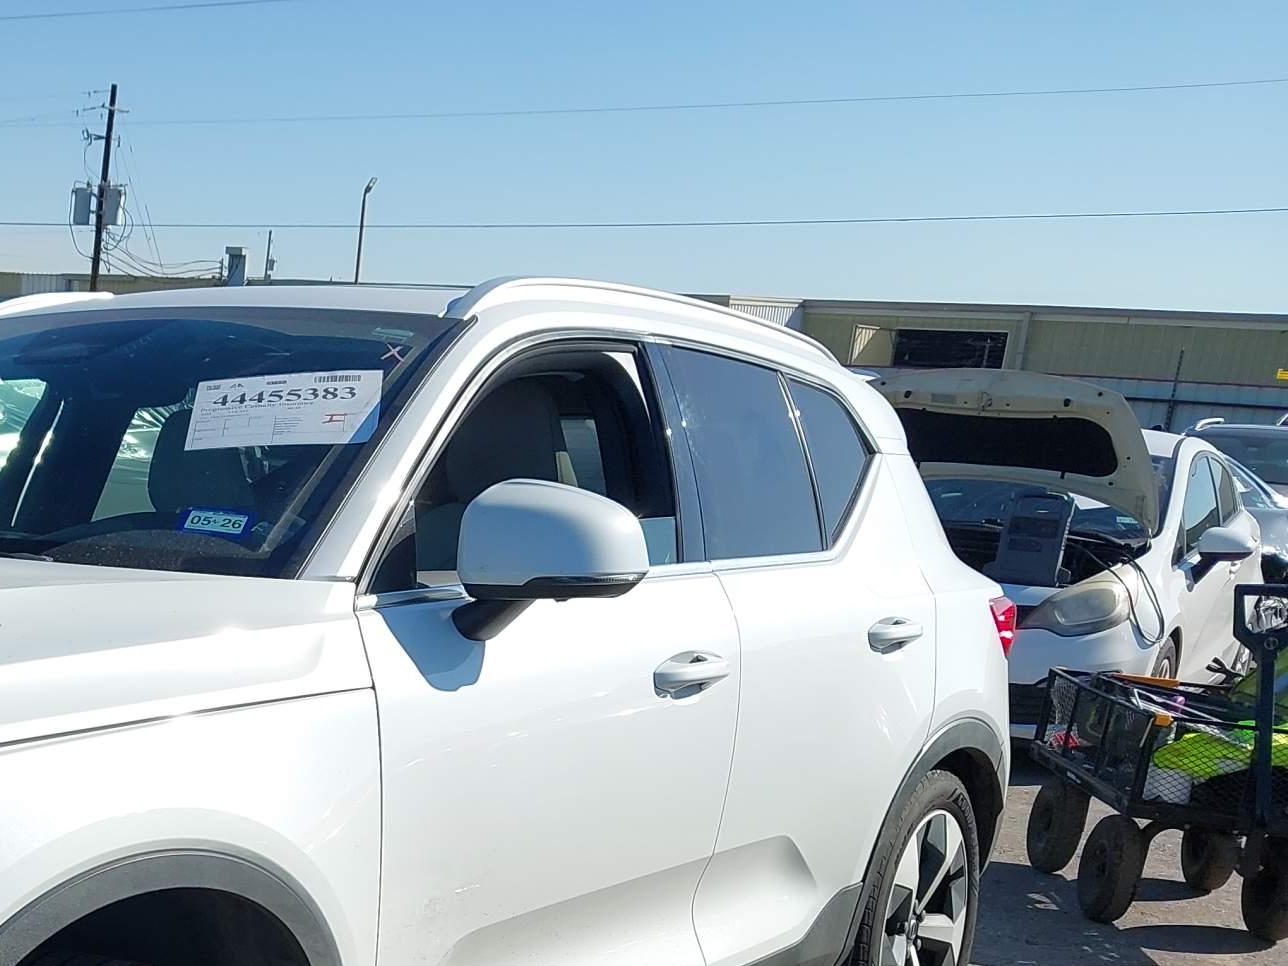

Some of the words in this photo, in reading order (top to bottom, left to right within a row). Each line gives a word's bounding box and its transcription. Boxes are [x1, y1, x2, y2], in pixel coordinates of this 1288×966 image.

[213, 386, 357, 407] 44455383
[191, 515, 212, 526] 05
[220, 518, 243, 529] 26
